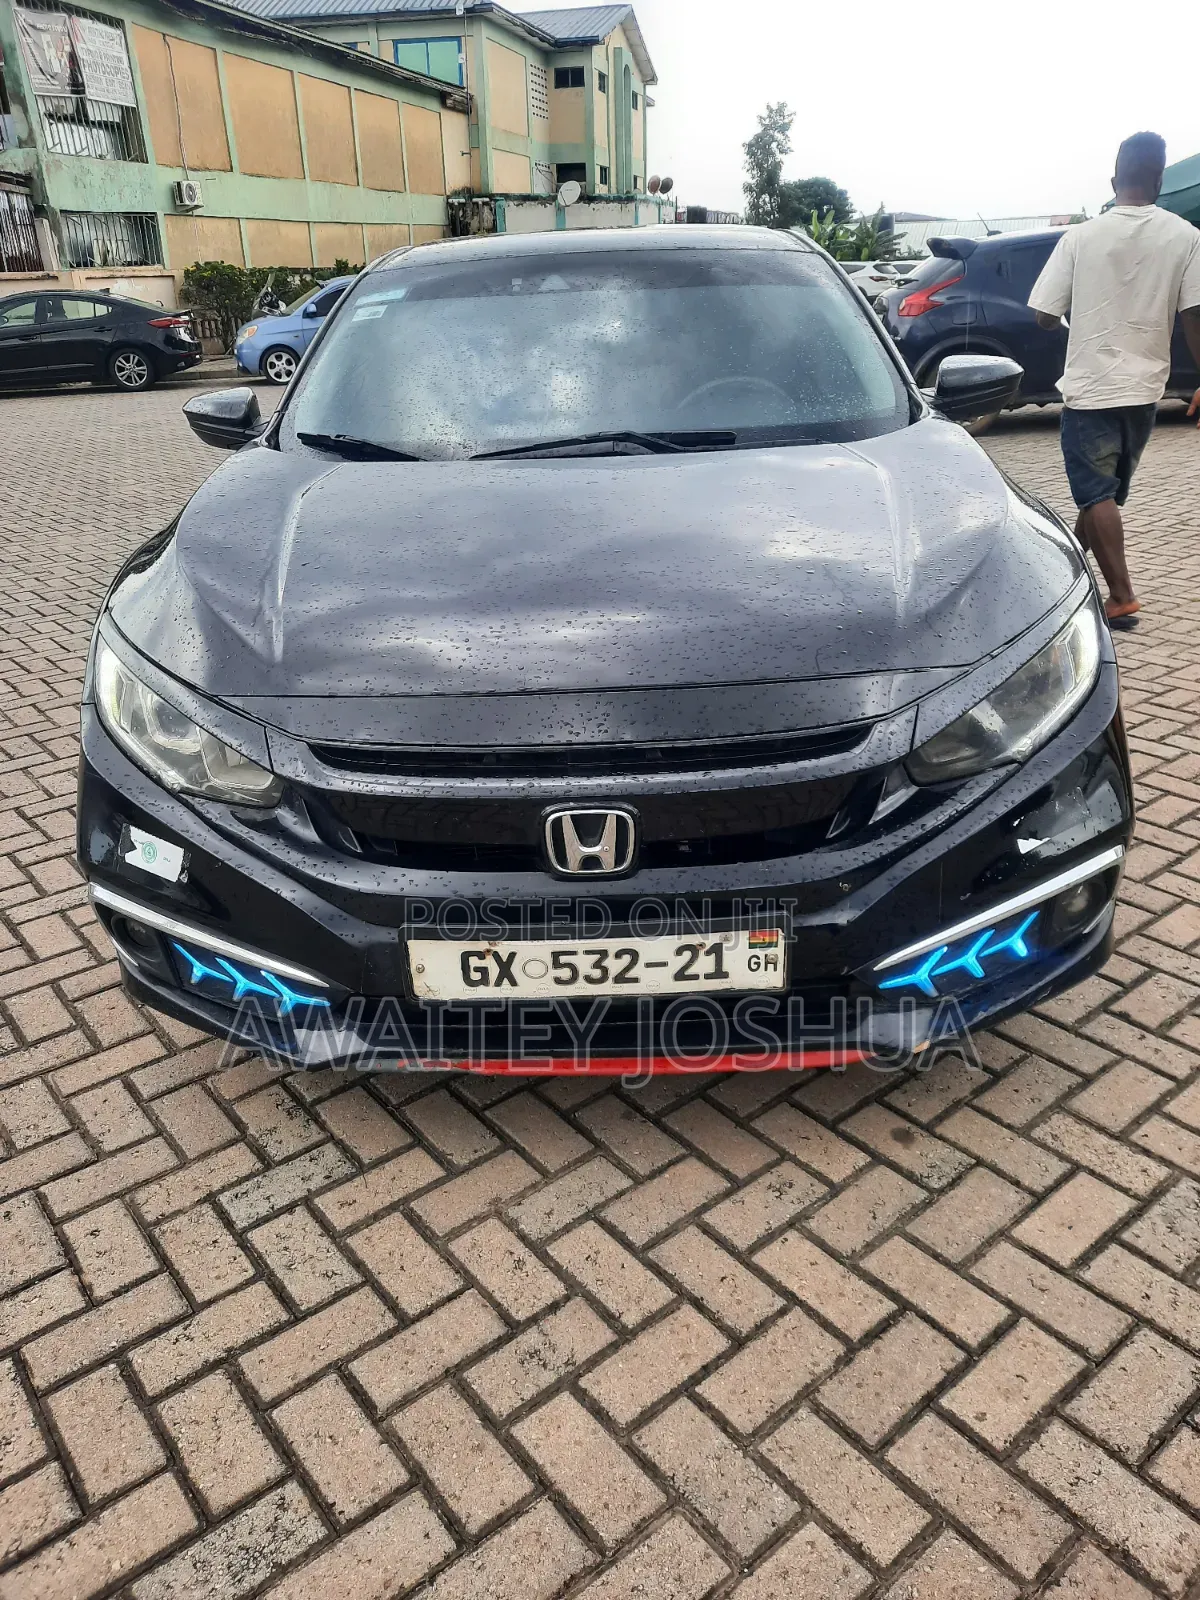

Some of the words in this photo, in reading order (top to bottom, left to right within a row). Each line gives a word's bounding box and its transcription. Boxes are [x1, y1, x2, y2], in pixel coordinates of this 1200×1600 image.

[460, 950, 518, 988] GX
[550, 942, 730, 986] 532-21
[747, 954, 778, 972] GH
